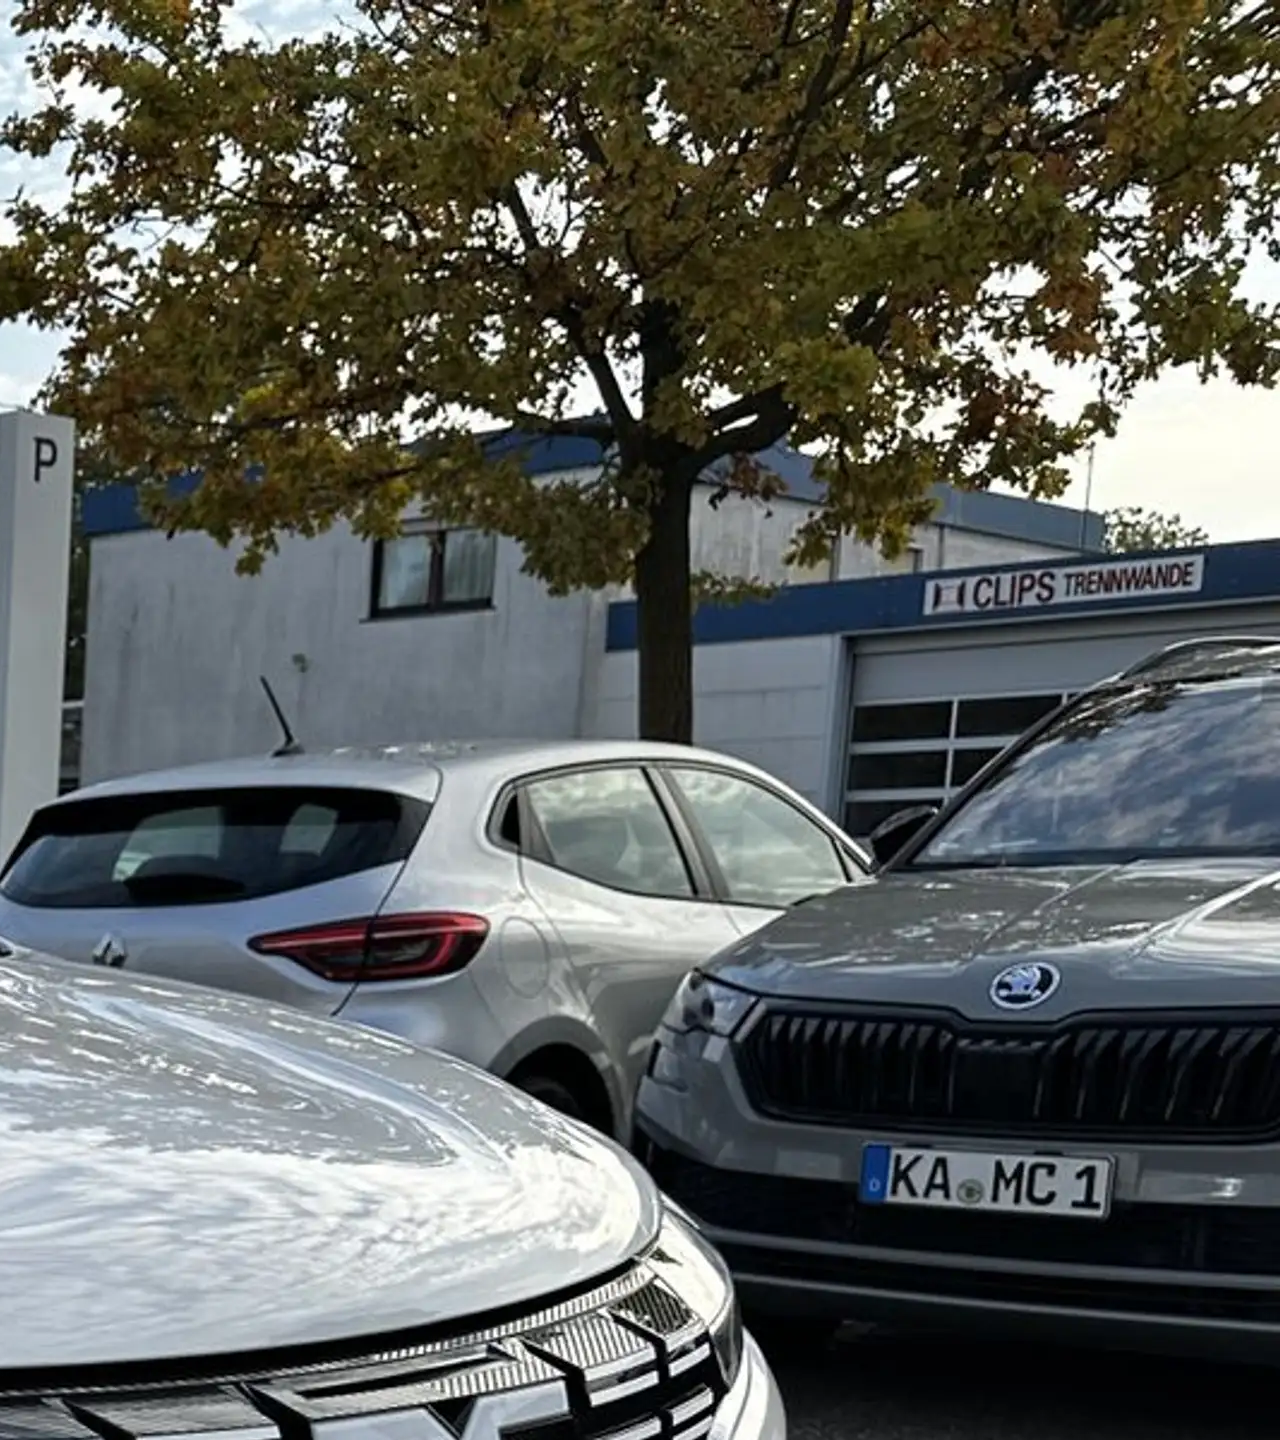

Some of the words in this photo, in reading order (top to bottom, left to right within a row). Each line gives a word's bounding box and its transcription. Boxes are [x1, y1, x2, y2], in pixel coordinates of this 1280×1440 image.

[32, 436, 58, 482] P
[972, 570, 1056, 609] CLIPS
[890, 1153, 951, 1200] KA
[991, 1158, 1057, 1207] MC
[1071, 1164, 1101, 1210] 1
